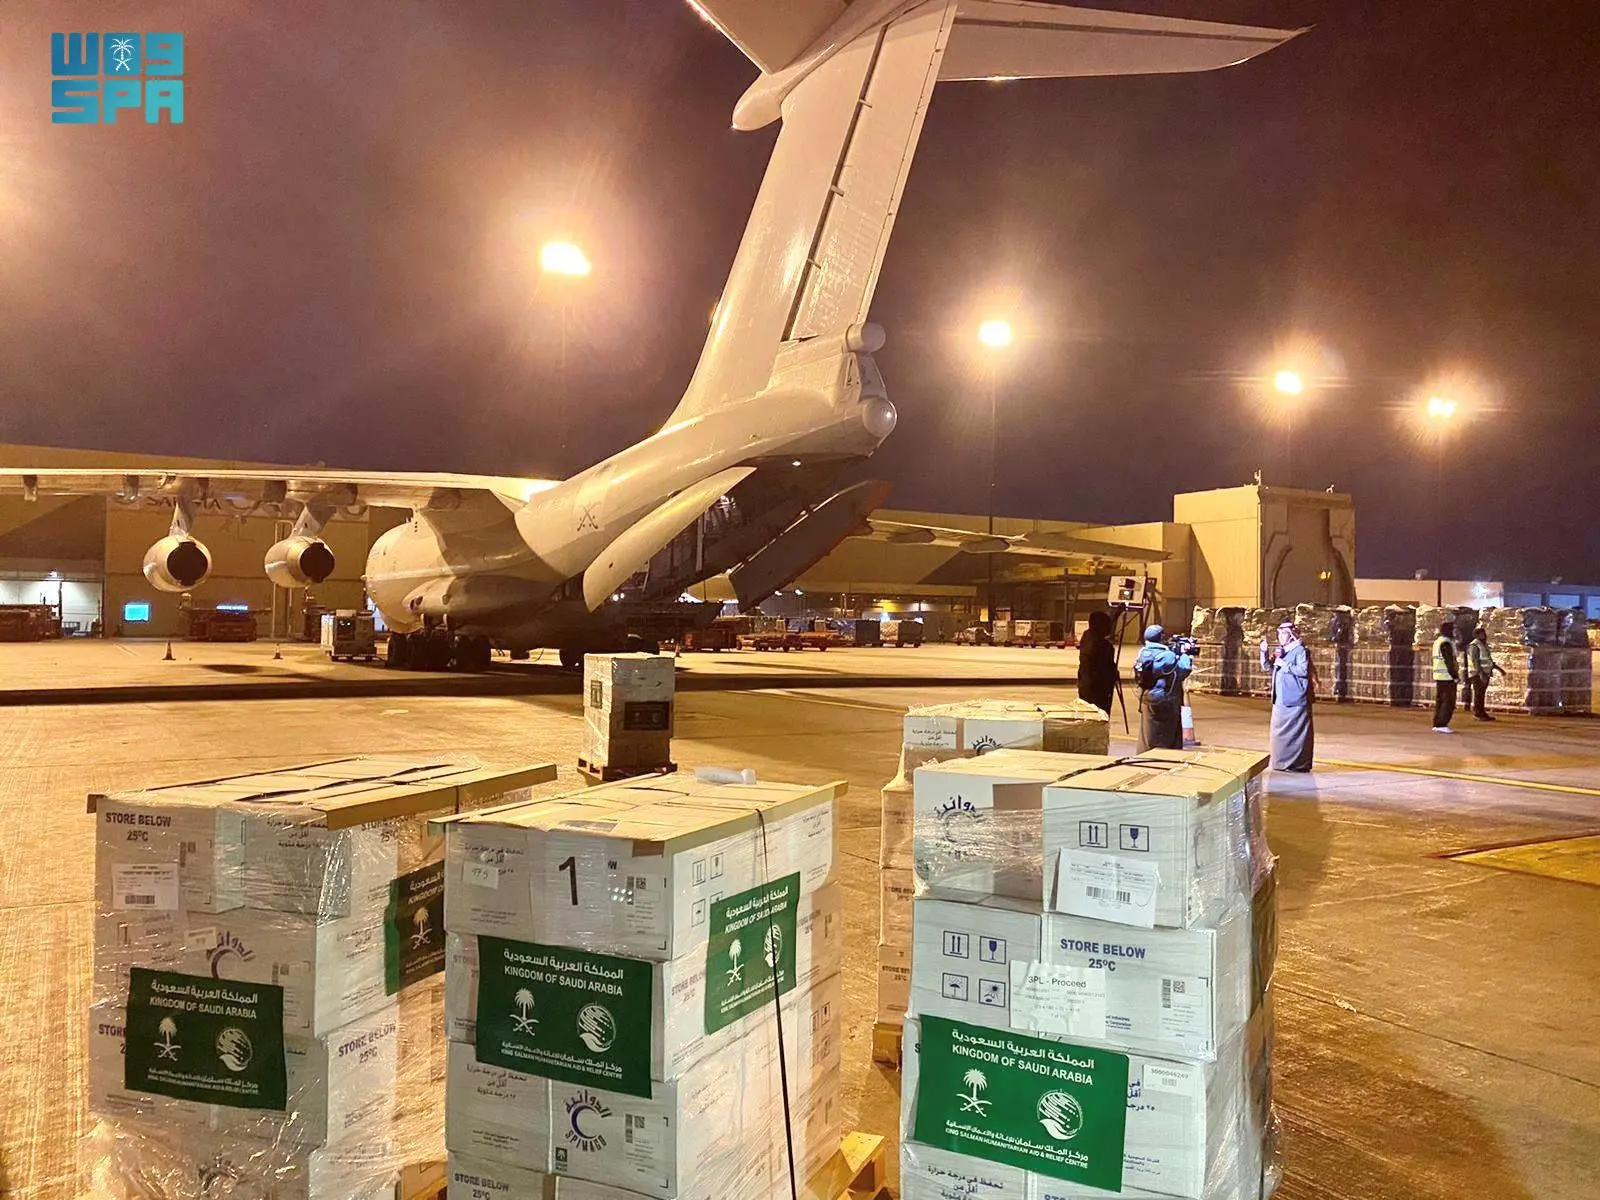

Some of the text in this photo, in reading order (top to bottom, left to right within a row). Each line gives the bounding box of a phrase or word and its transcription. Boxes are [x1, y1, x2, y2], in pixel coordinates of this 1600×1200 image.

[106, 812, 172, 828] STORE BELOW
[559, 856, 578, 906] 1
[725, 916, 749, 934] KINGDOM
[1060, 938, 1146, 959] STORE BELOW
[504, 948, 624, 980] المملكة العربية السعودية
[151, 979, 258, 1004] المملكة العربية السعودية
[504, 965, 623, 996] KINGDOM OF SAUDI ARABIA
[1028, 975, 1044, 985] 3PL
[1051, 977, 1087, 989] Proceed
[149, 996, 257, 1019] KINGDOM OF SAUDI ARABIA
[338, 1034, 367, 1058] STORE
[952, 1028, 1095, 1069] المملكة العربية السعودية
[952, 1044, 1094, 1085] KINGDOM OF SAUDI ARABIA
[1126, 1102, 1145, 1112] درج
[565, 1129, 607, 1153] SPIMACO
[960, 1130, 983, 1143] SALMAN
[983, 1138, 1029, 1154] HUMANITARIAN
[1028, 1149, 1040, 1157] AID
[1045, 1152, 1065, 1162] RELIEF
[1065, 1157, 1088, 1169] CENTRE
[1015, 1137, 1044, 1150] سلمان
[1044, 1144, 1068, 1156] الملك
[1068, 1150, 1089, 1162] مركز
[455, 1173, 480, 1186] STORE
